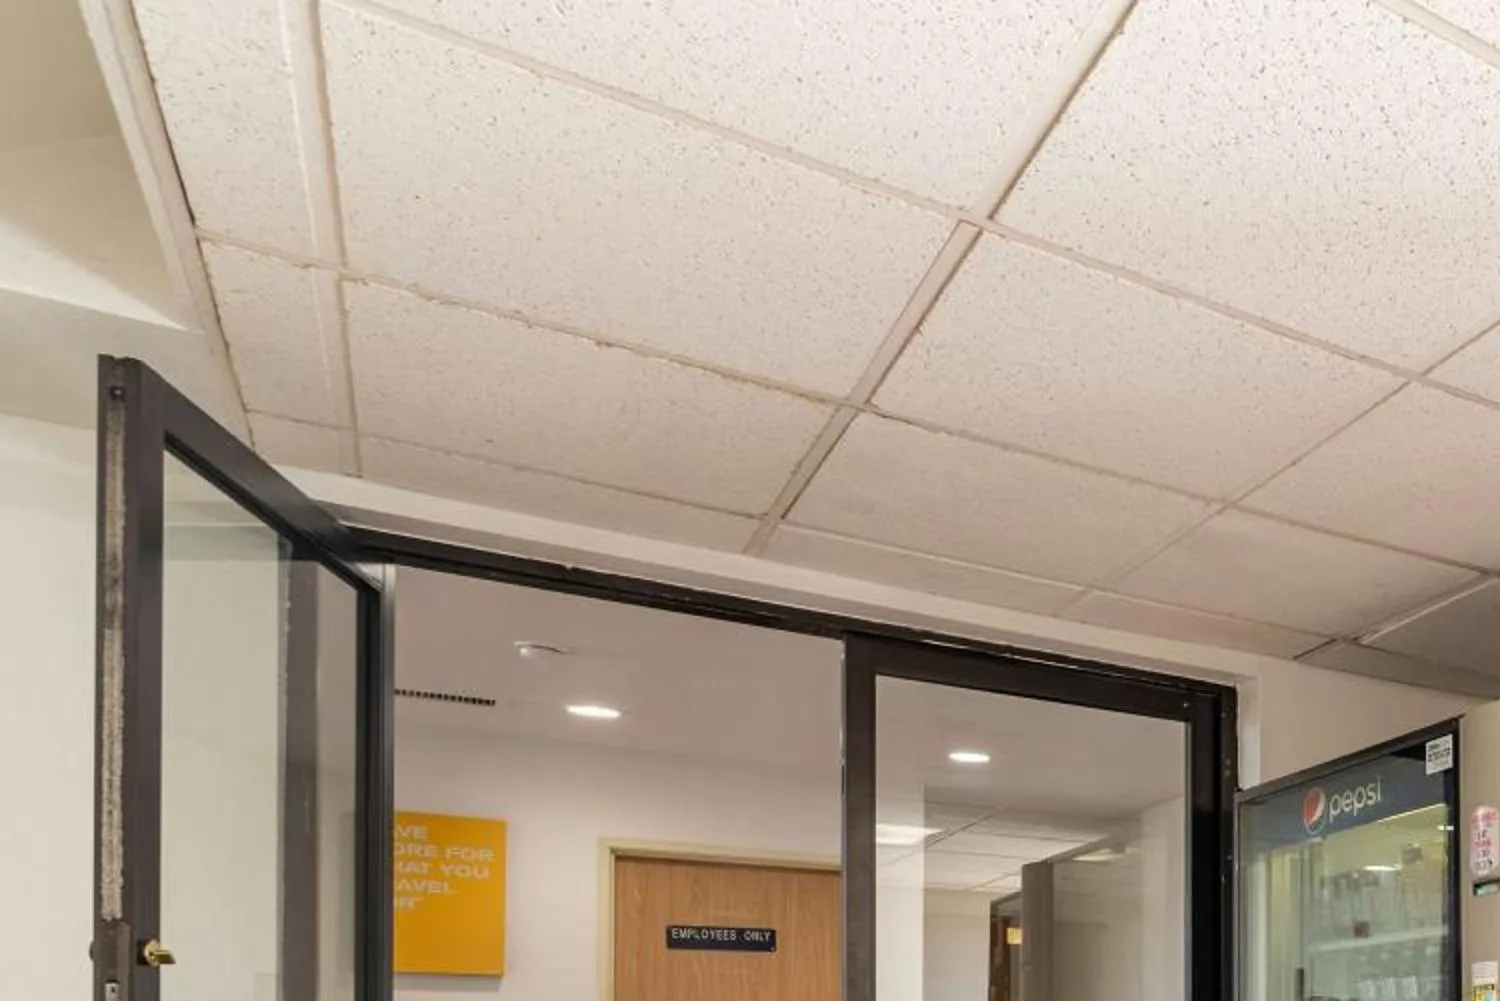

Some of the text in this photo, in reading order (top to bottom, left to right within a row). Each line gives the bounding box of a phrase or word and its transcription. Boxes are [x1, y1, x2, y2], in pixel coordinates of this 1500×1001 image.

[1329, 776, 1381, 823] pepsi
[445, 847, 495, 862] FOR
[441, 864, 490, 879] YOU
[672, 927, 772, 942] EMPLOYEES ONLY
